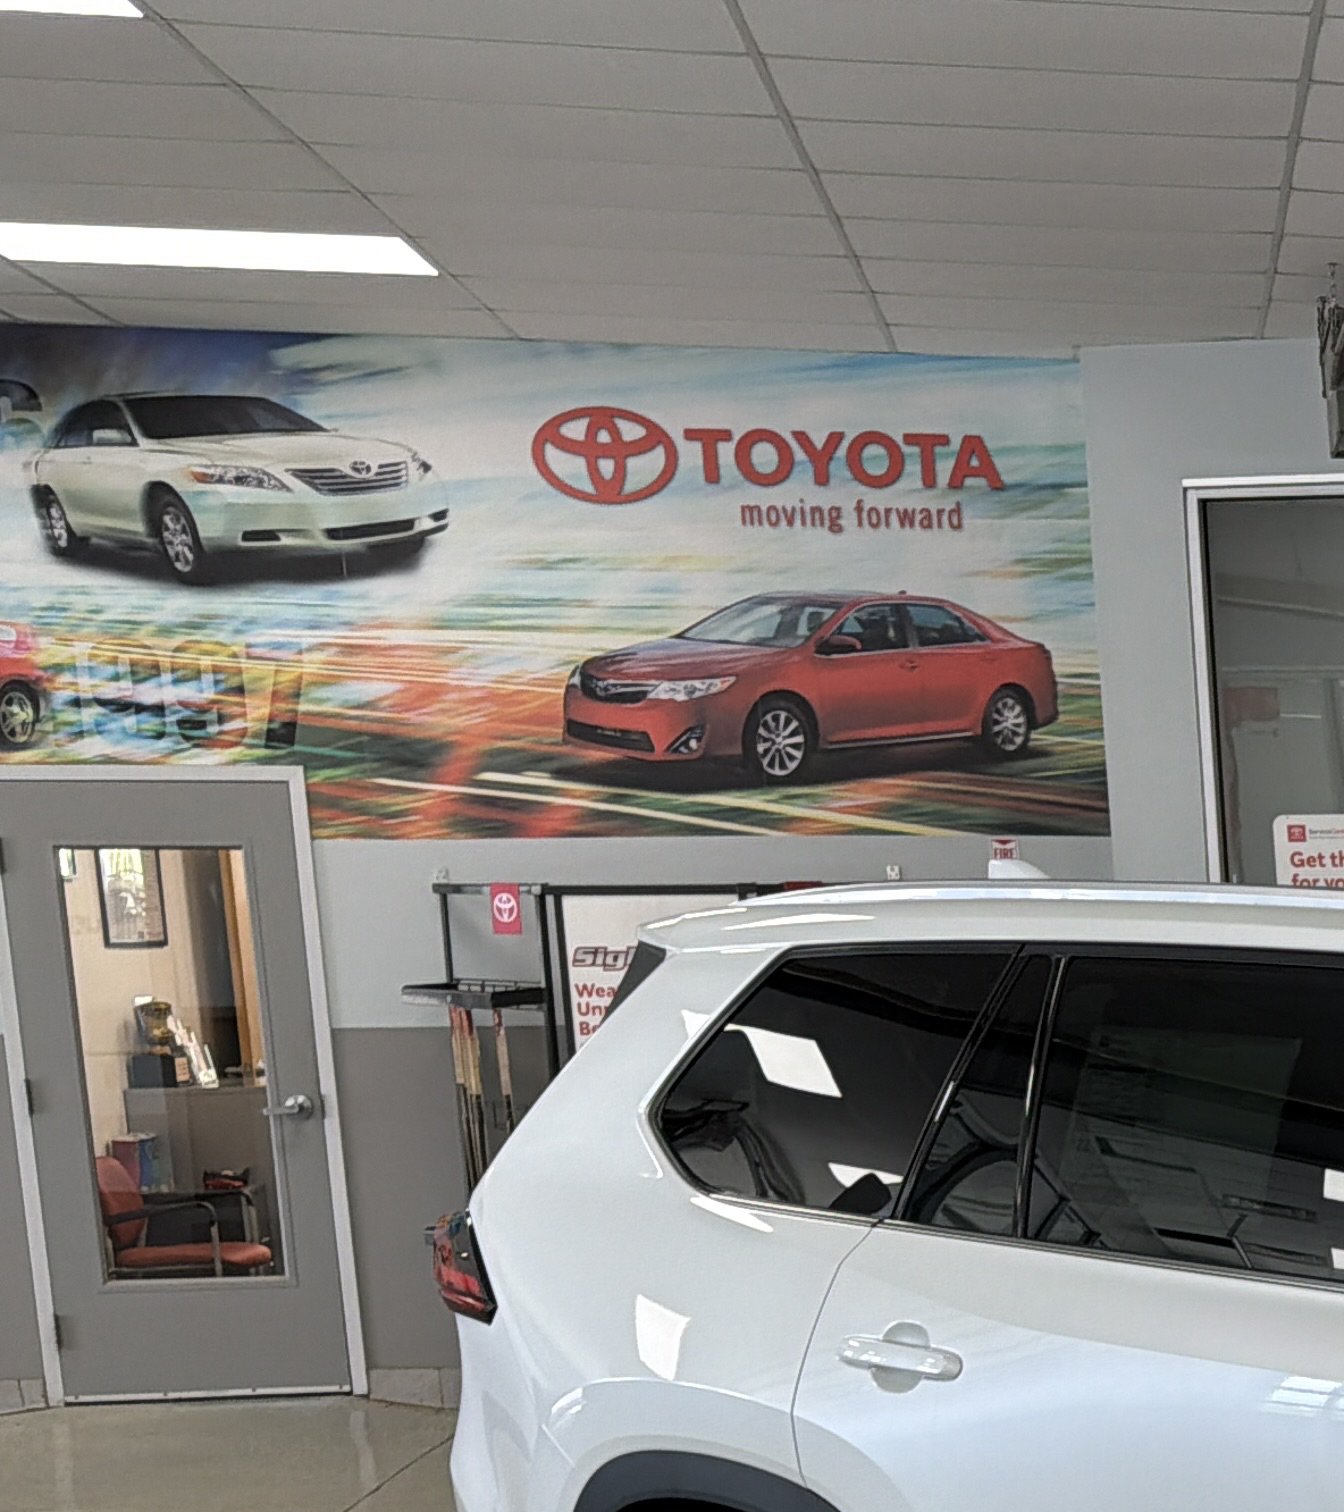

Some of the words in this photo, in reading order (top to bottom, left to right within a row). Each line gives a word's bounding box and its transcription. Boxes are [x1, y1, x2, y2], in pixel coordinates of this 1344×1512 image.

[684, 428, 1005, 491] TOYOTA
[740, 498, 844, 535] moving
[855, 501, 964, 531] forward
[993, 847, 1017, 860] FIRE
[1289, 850, 1326, 868] Get
[1290, 873, 1321, 887] for
[574, 982, 617, 998] Wea
[577, 1002, 608, 1017] Un
